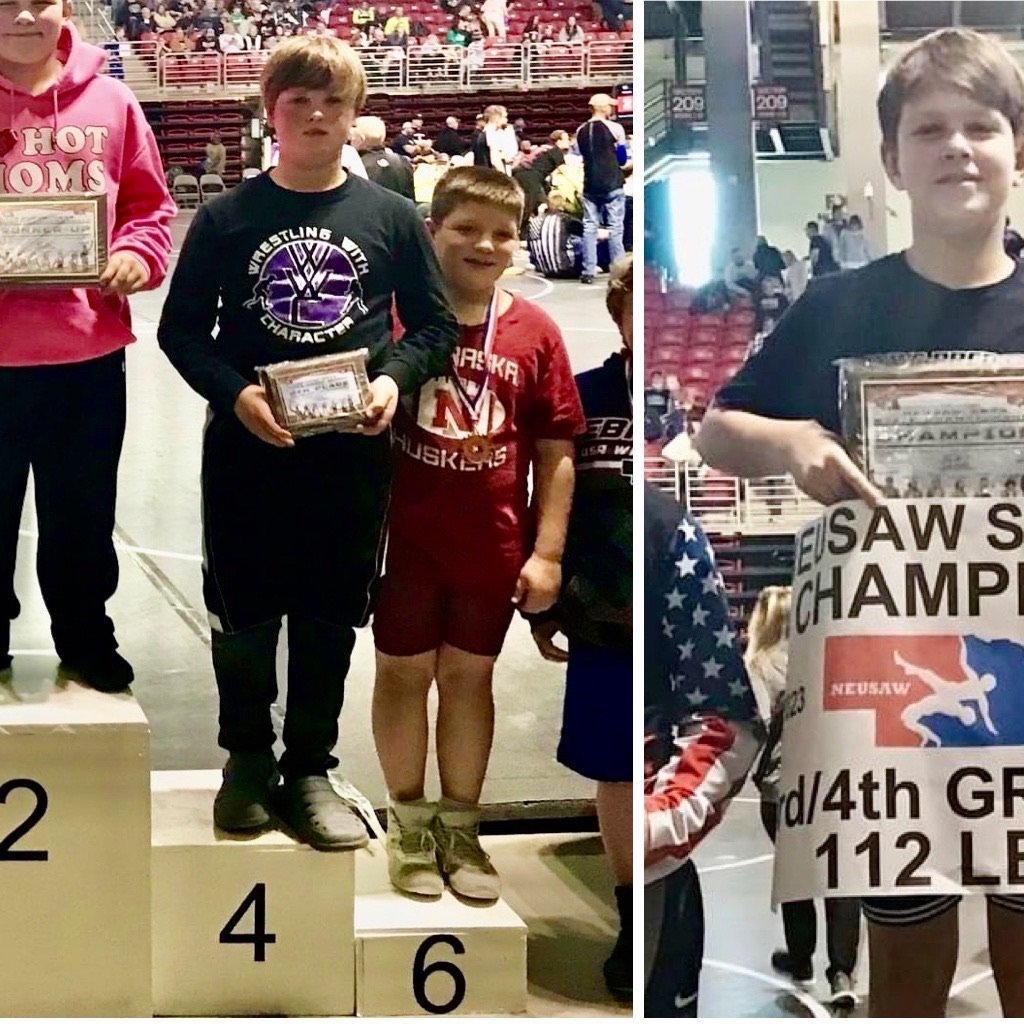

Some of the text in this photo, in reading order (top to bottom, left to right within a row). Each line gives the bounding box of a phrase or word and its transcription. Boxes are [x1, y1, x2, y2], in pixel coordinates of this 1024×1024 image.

[673, 96, 704, 111] 209
[756, 95, 788, 109] 209
[22, 125, 109, 156] HOT
[0, 160, 106, 193] OMS
[248, 226, 332, 275] WRESTLING
[260, 314, 354, 343] CHARACTER
[830, 681, 911, 697] NEUSAW
[0, 778, 48, 861] 2
[816, 830, 931, 889] 112
[219, 882, 276, 962] 4
[412, 934, 467, 1014] 6
